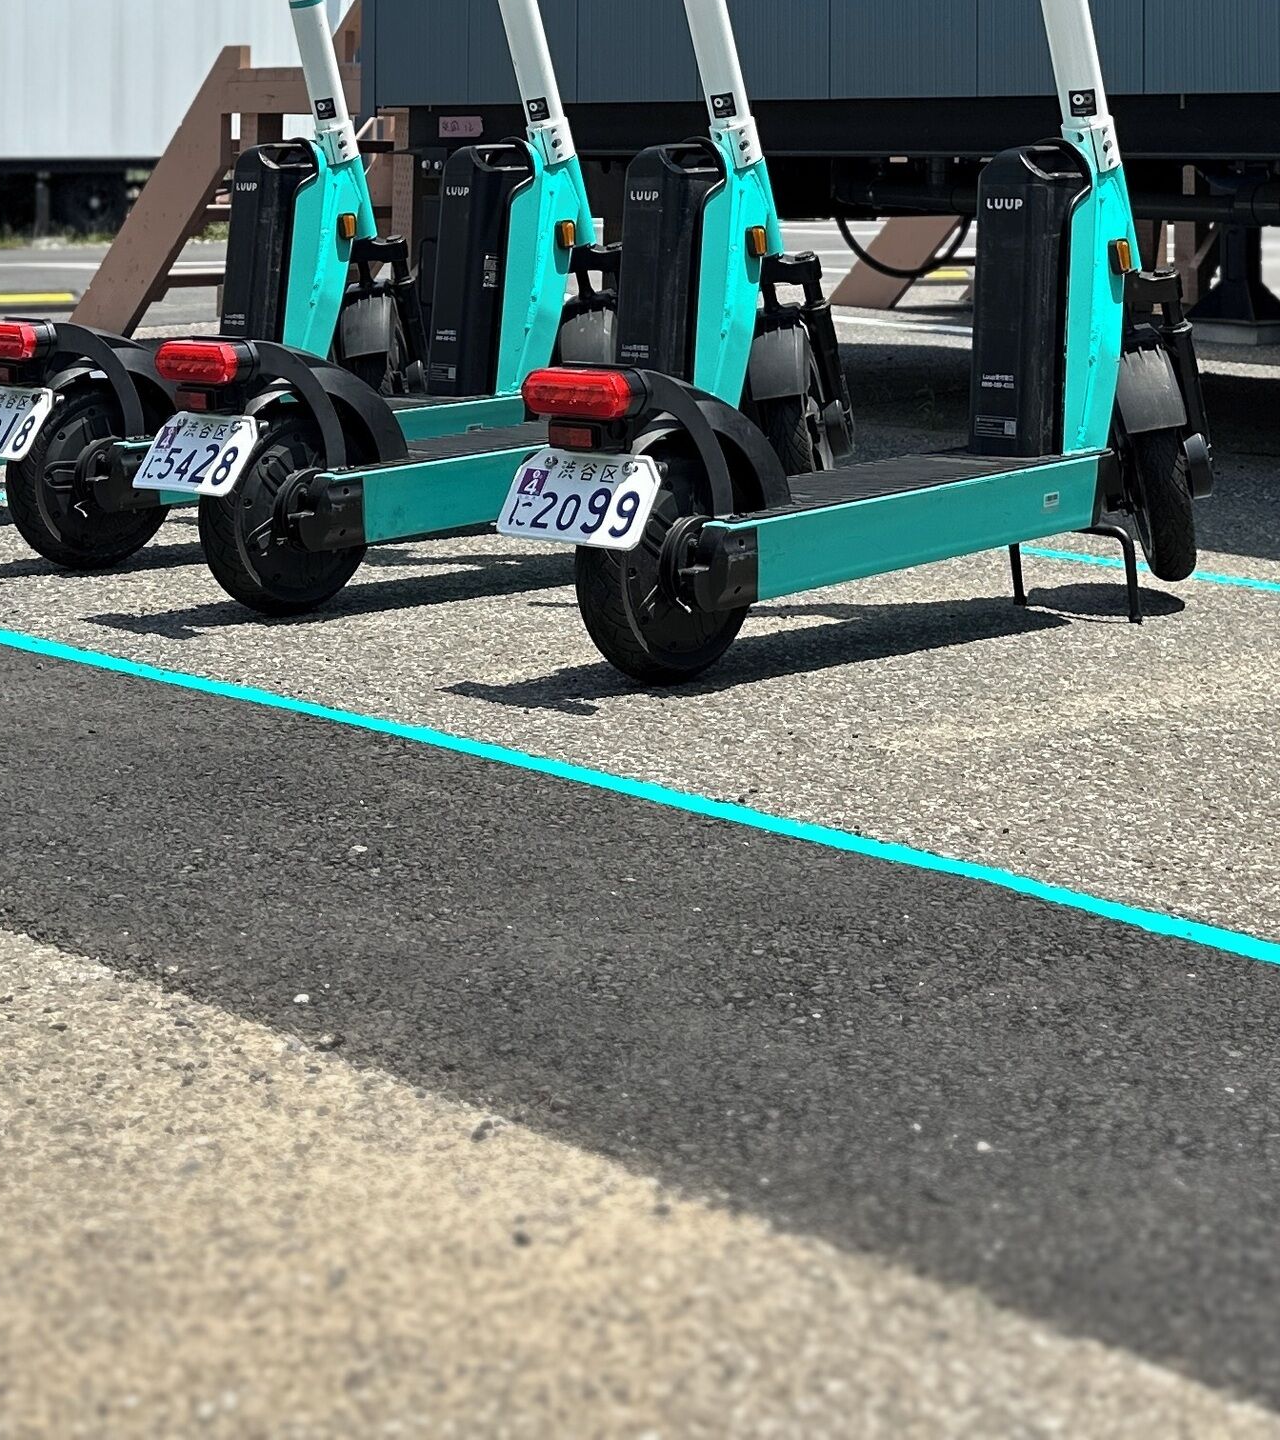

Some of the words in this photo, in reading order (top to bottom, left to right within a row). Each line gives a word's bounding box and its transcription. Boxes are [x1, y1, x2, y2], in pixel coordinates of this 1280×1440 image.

[236, 183, 257, 191] LUUP
[446, 186, 470, 196] LUUP
[630, 190, 659, 201] LUUP
[986, 198, 1023, 210] LUUP
[557, 460, 619, 484] 渋谷区
